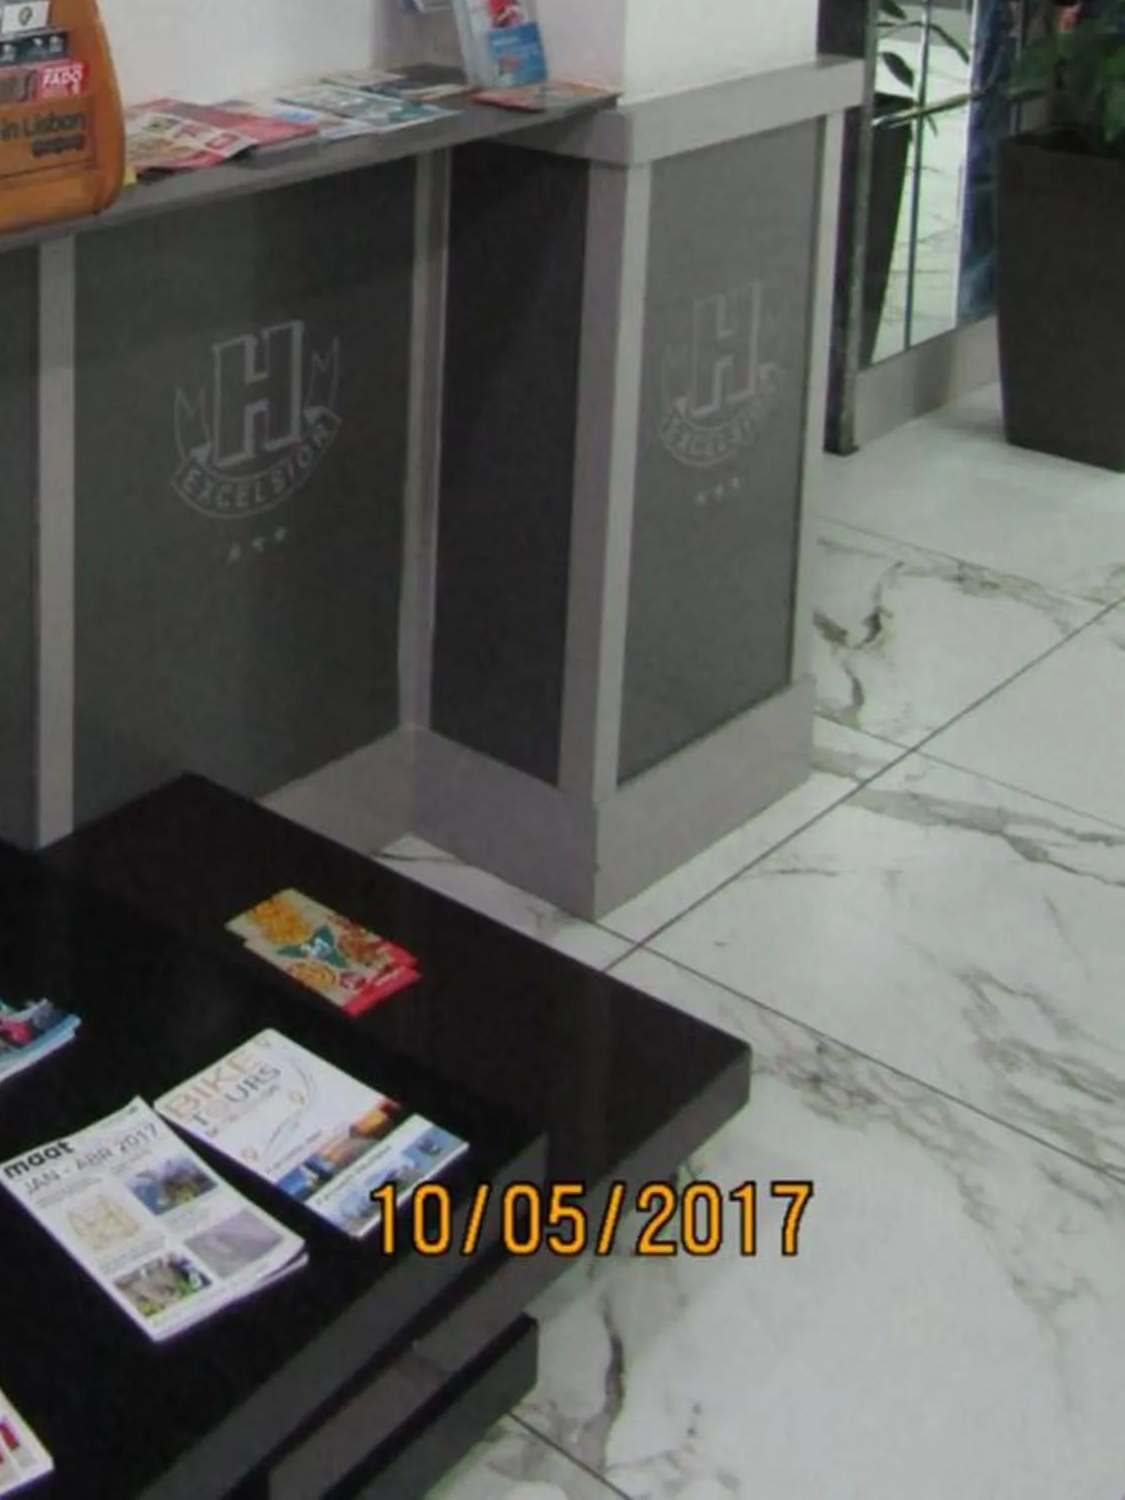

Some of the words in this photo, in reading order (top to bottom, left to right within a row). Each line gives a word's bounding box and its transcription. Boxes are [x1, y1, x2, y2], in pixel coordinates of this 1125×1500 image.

[1, 118, 20, 141] in
[23, 111, 88, 138] Lisbon
[211, 320, 304, 469] H
[3, 1140, 75, 1179] maat
[24, 1169, 60, 1195] JAN
[119, 1122, 159, 1153] 2017
